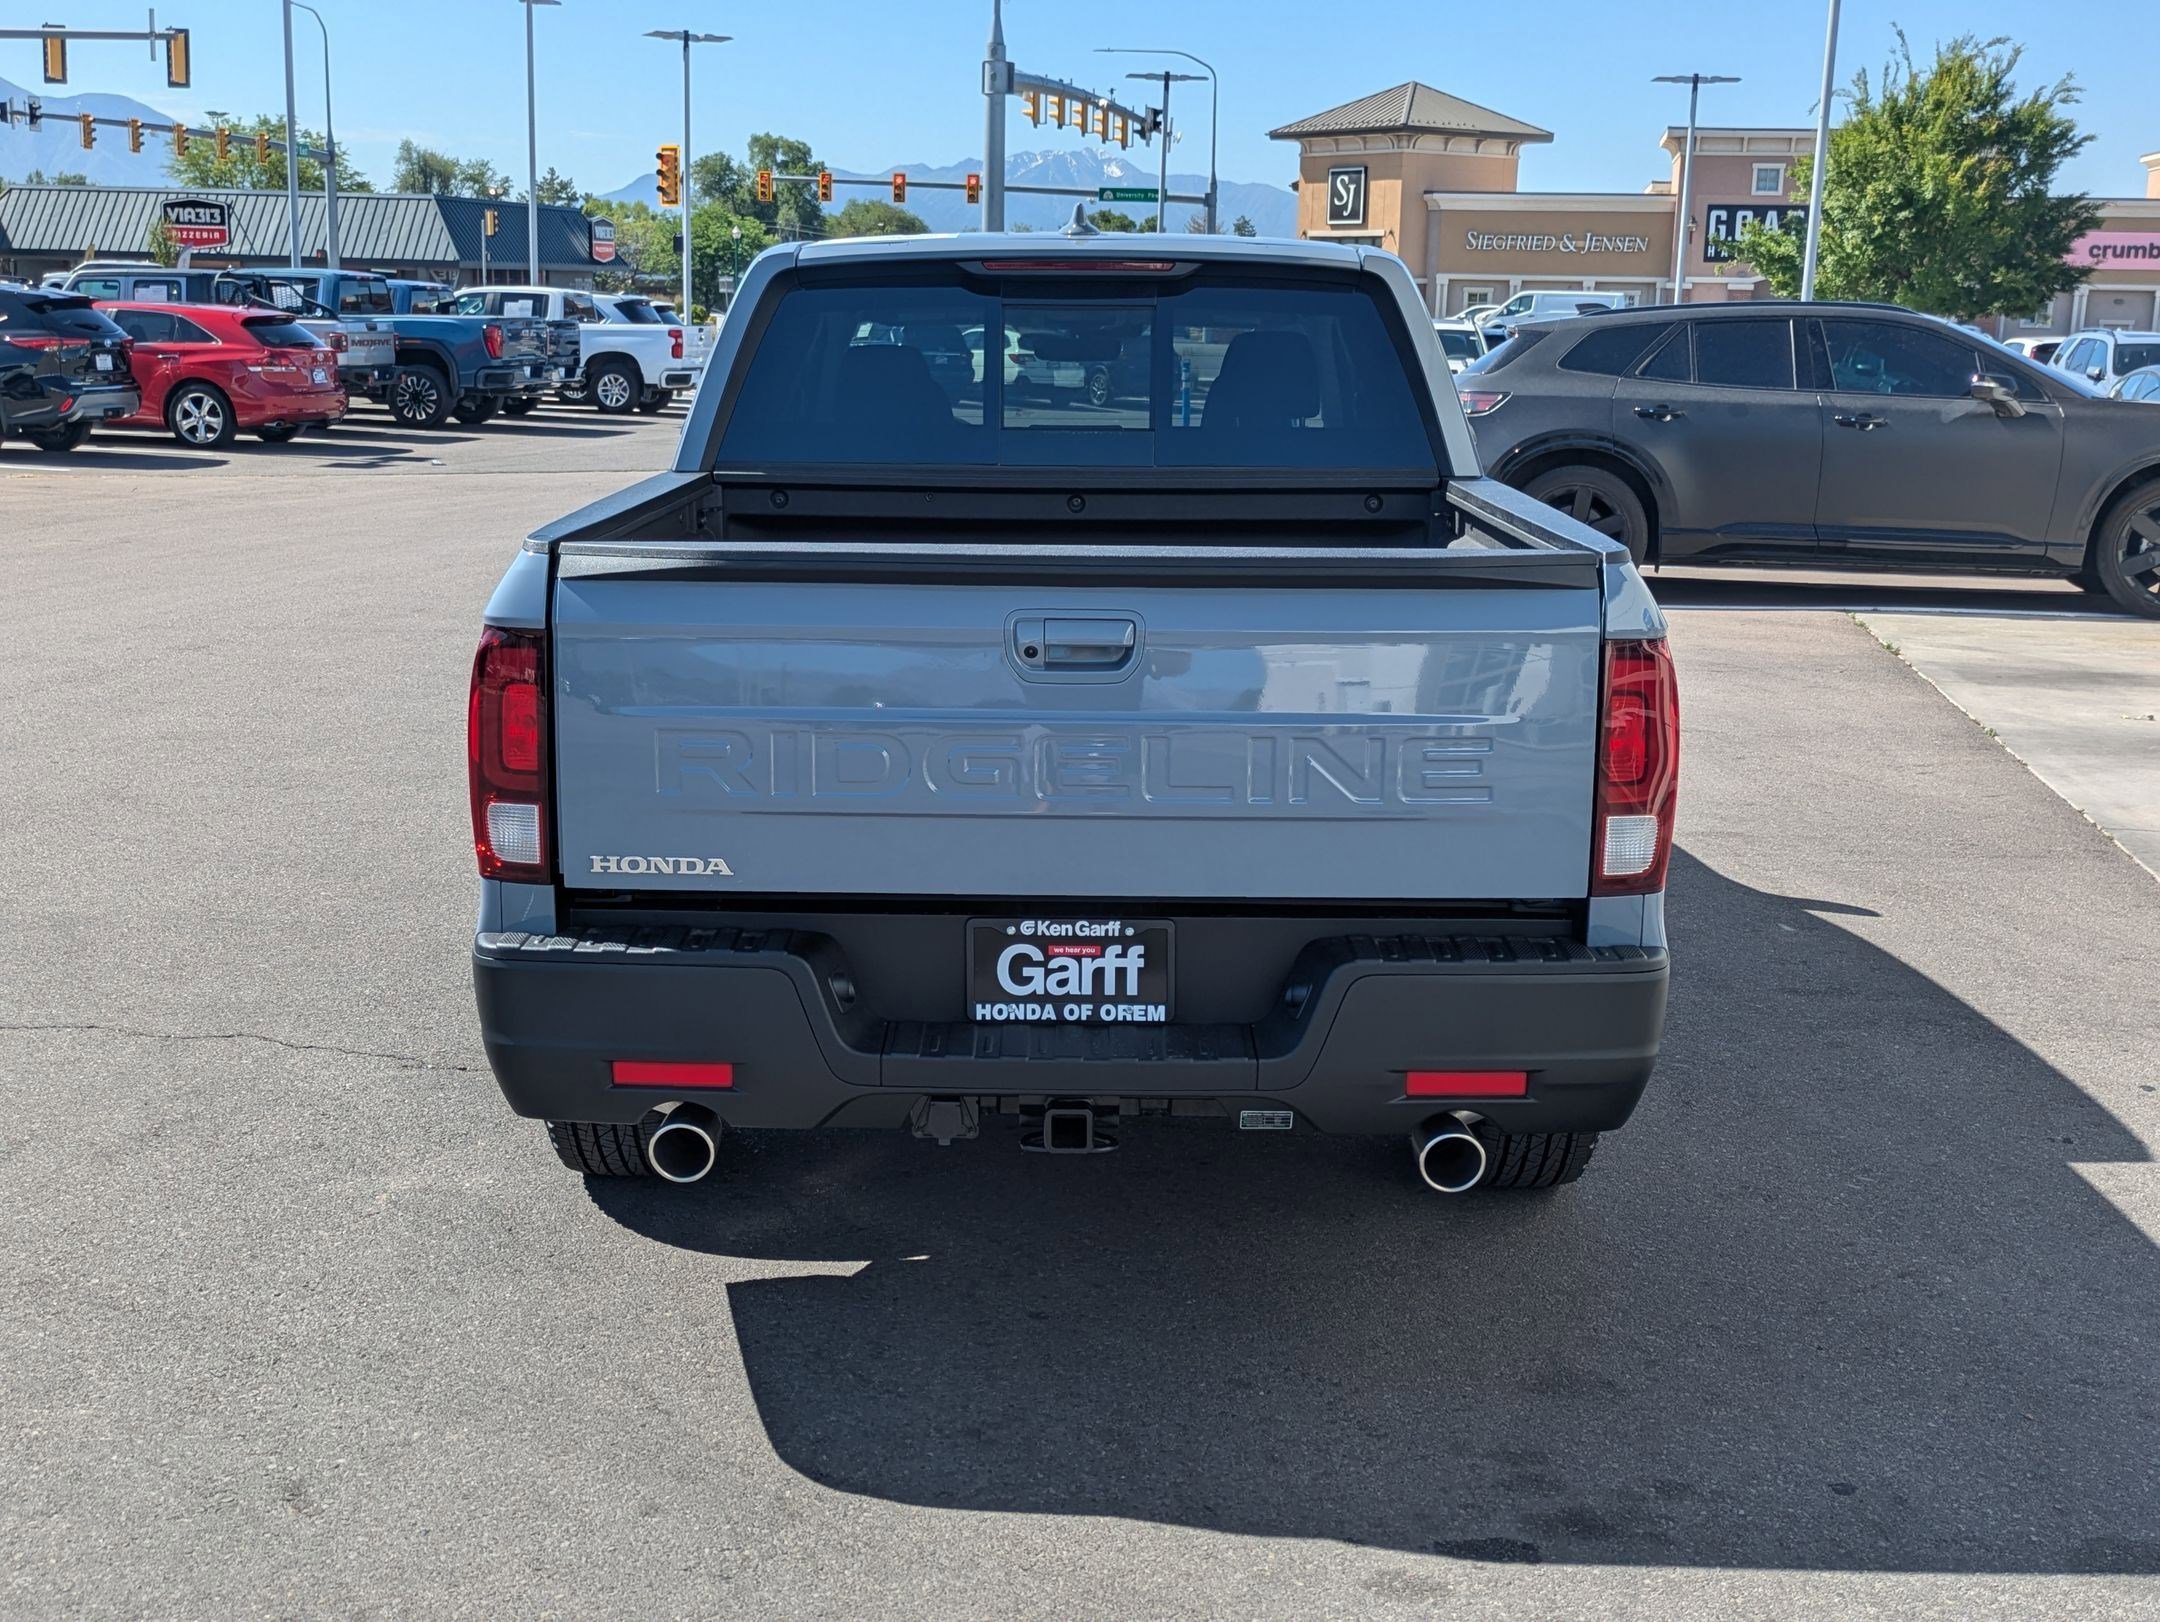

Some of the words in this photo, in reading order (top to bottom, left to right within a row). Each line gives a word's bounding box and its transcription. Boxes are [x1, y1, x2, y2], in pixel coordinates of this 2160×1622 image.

[1334, 175, 1356, 216] SJ
[1466, 231, 1556, 250] SIEGFRIED
[1559, 234, 1577, 252] &
[1580, 232, 1648, 254] JENSEN
[2088, 242, 2160, 259] crumb
[655, 727, 1494, 804] RIDGELINE
[589, 855, 734, 876] HONDA
[1037, 920, 1072, 936] Ken
[1075, 920, 1120, 937] Garff
[997, 944, 1145, 996] Garff
[976, 1003, 1057, 1021] HONDA
[1063, 1004, 1093, 1021] OF
[1100, 1004, 1166, 1022] OREM
